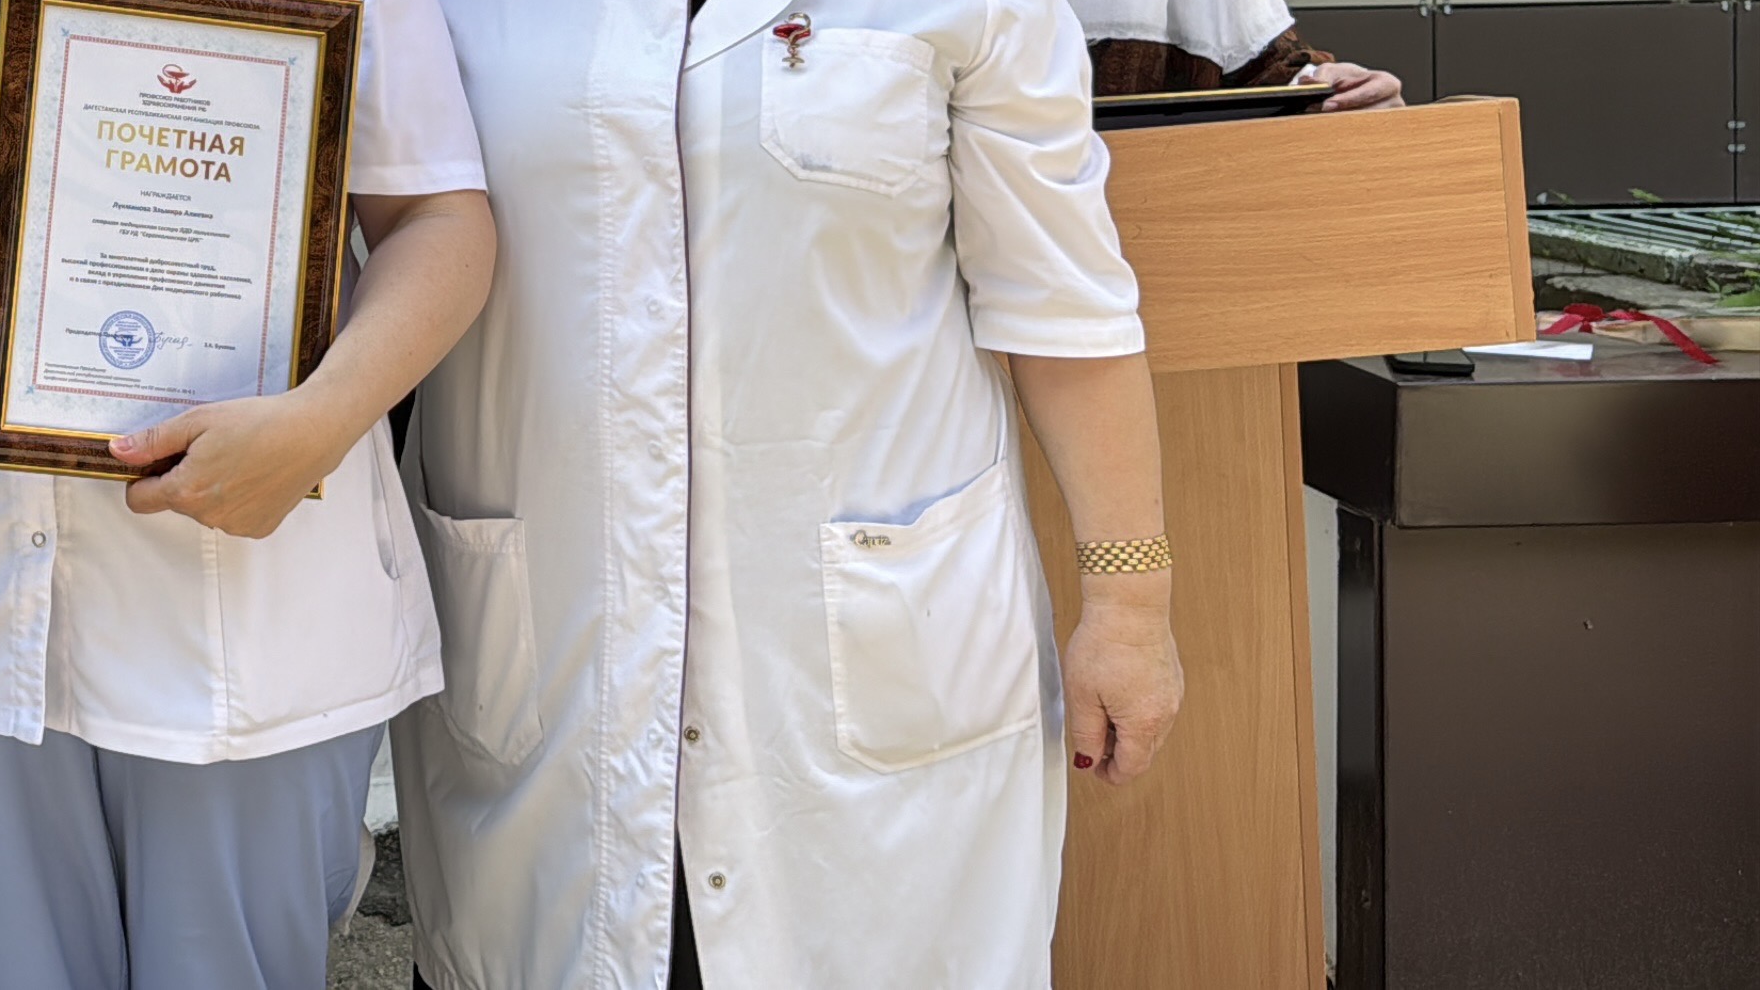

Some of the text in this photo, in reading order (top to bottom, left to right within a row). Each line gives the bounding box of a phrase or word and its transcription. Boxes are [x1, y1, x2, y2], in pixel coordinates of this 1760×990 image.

[97, 119, 245, 157] ПОЧЕТНАЯ
[105, 148, 232, 183] ГРАМОТА
[140, 190, 191, 202] НАГРАЖДАЕТСЯ
